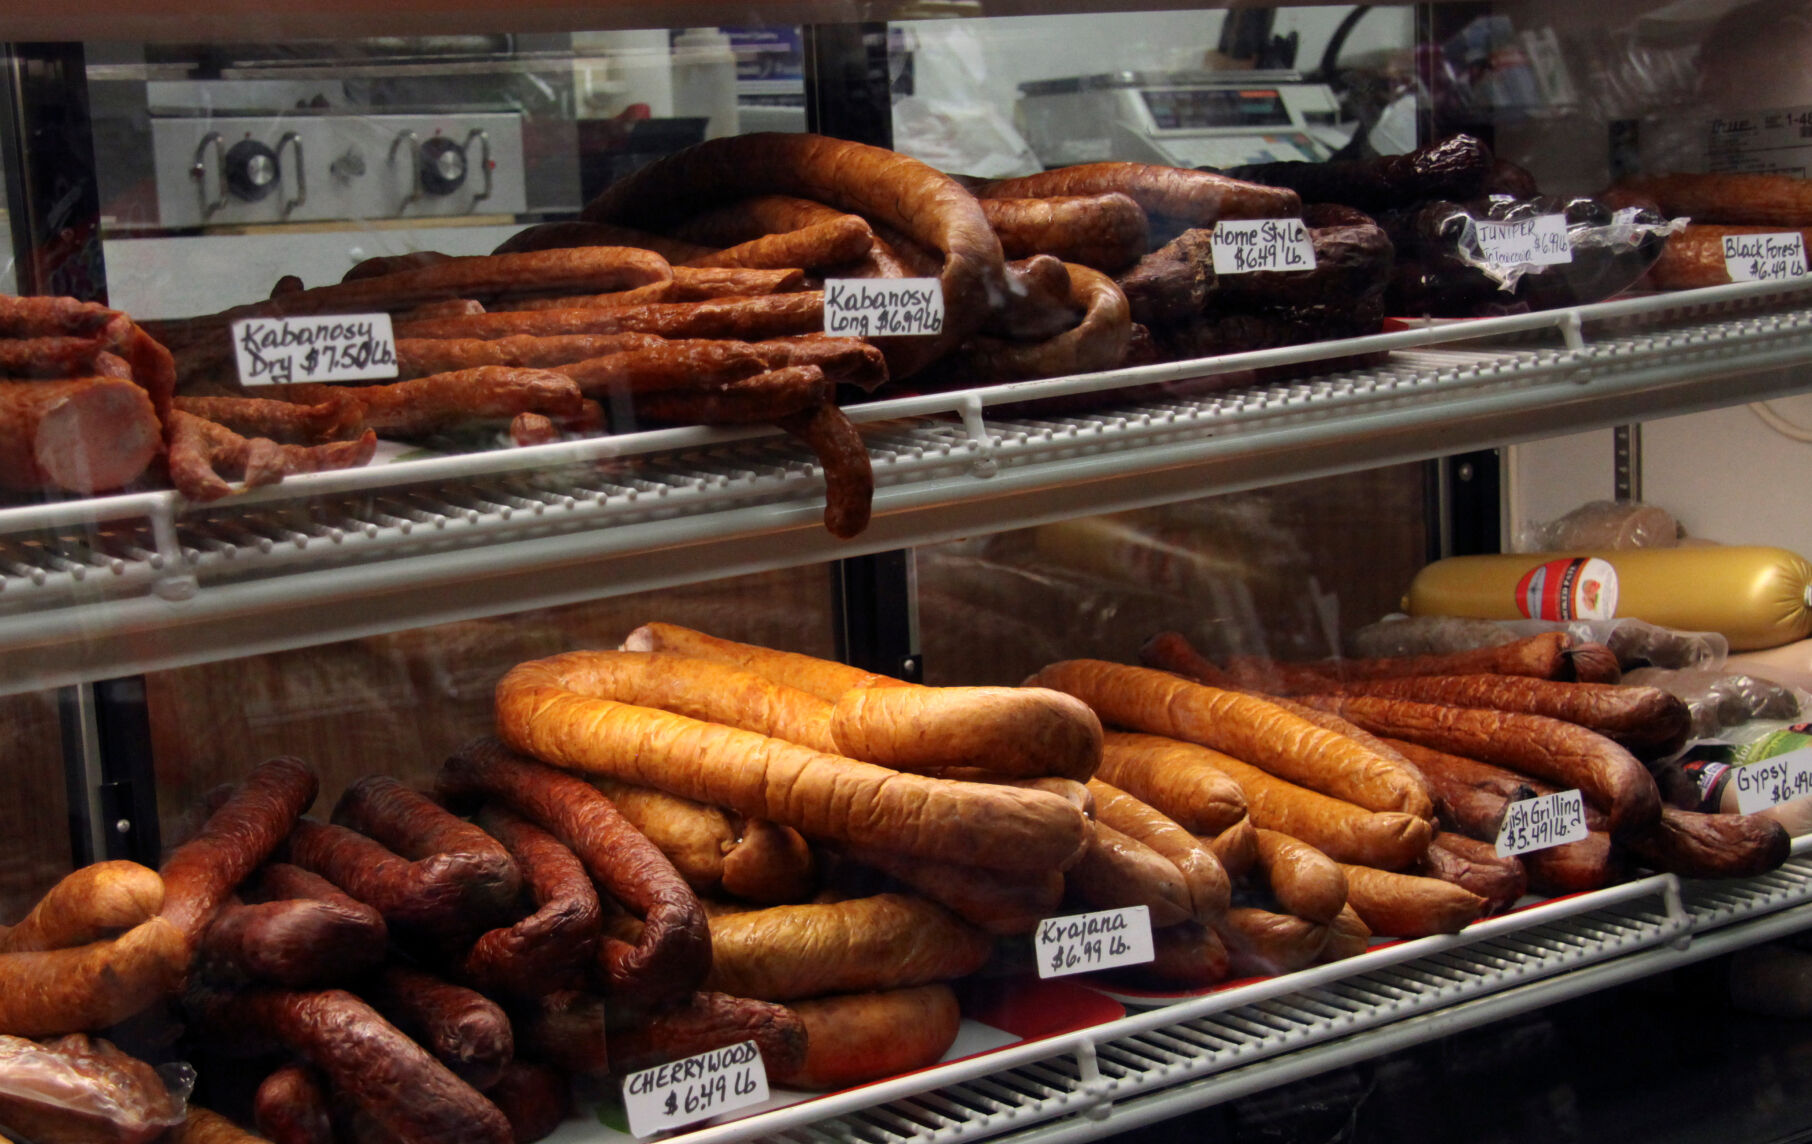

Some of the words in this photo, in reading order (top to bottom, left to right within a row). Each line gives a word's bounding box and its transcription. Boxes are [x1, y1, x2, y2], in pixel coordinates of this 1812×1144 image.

[1214, 223, 1258, 246] Home
[1261, 221, 1304, 253] Style
[1479, 220, 1537, 242] JUNIPER
[1725, 236, 1764, 259] Black
[1765, 235, 1801, 259] Forest
[1234, 244, 1276, 270] $6.49
[1749, 259, 1786, 280] $6.49
[827, 285, 934, 312] Kabanosy
[241, 321, 373, 353] Kabanosy
[831, 310, 869, 336] Long
[248, 349, 292, 383] Dry
[1737, 761, 1788, 794] Gypsy
[1530, 794, 1581, 827] Grilling
[1041, 913, 1128, 946] Krajana
[1051, 939, 1102, 972] $6.99
[629, 1042, 757, 1096] CHERRYWOOD
[663, 1074, 726, 1117] $6.49
